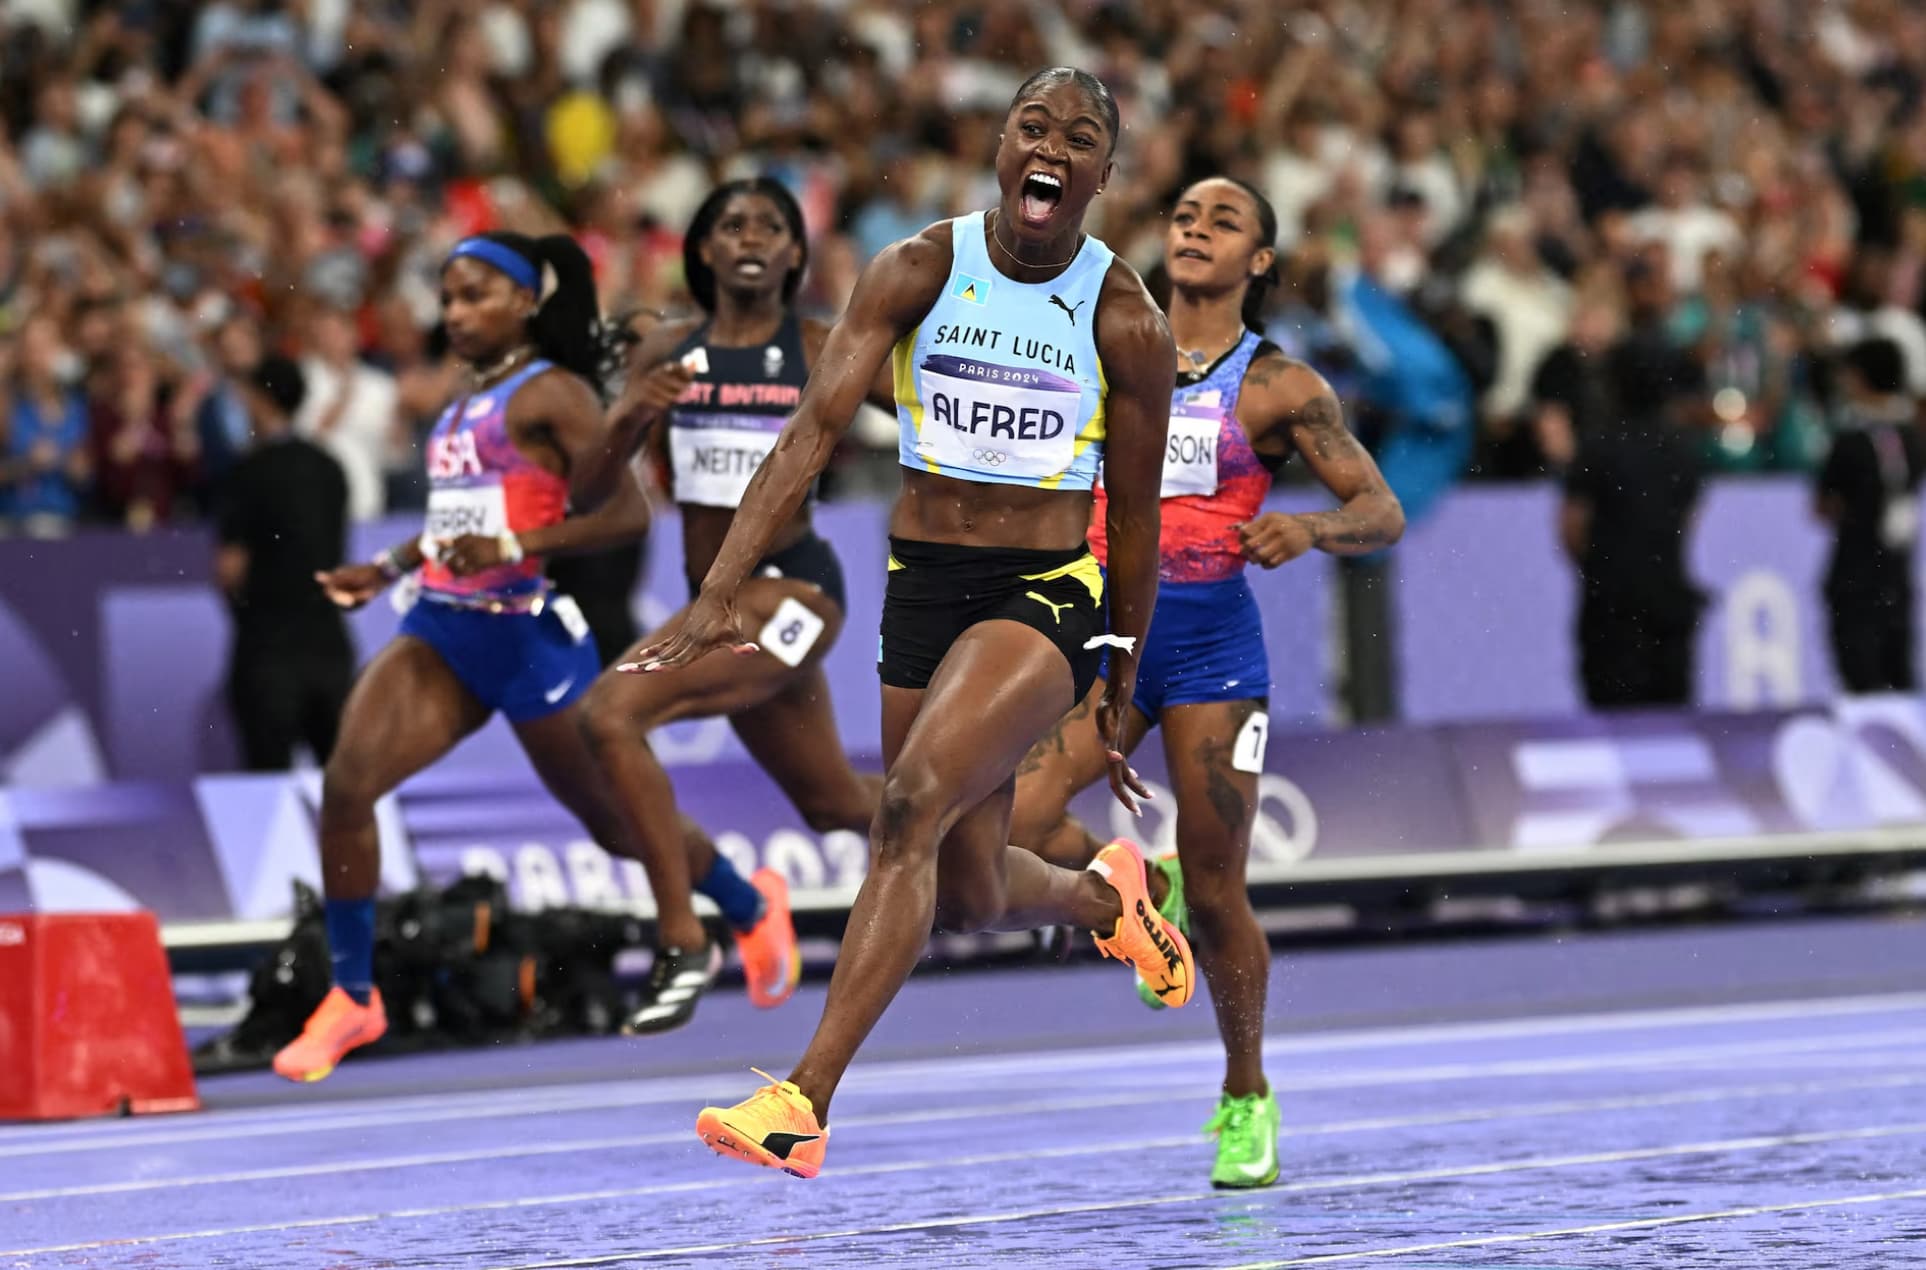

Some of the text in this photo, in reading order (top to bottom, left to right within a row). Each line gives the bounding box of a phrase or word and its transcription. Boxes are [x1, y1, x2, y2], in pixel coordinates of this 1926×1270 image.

[934, 325, 1076, 375] SAINT LUCIA
[959, 363, 1039, 384] PARIS 2024
[932, 392, 1064, 440] ALFRED
[780, 619, 804, 646] 8
[461, 840, 657, 917] PARI
[1136, 898, 1184, 977] NITRO
